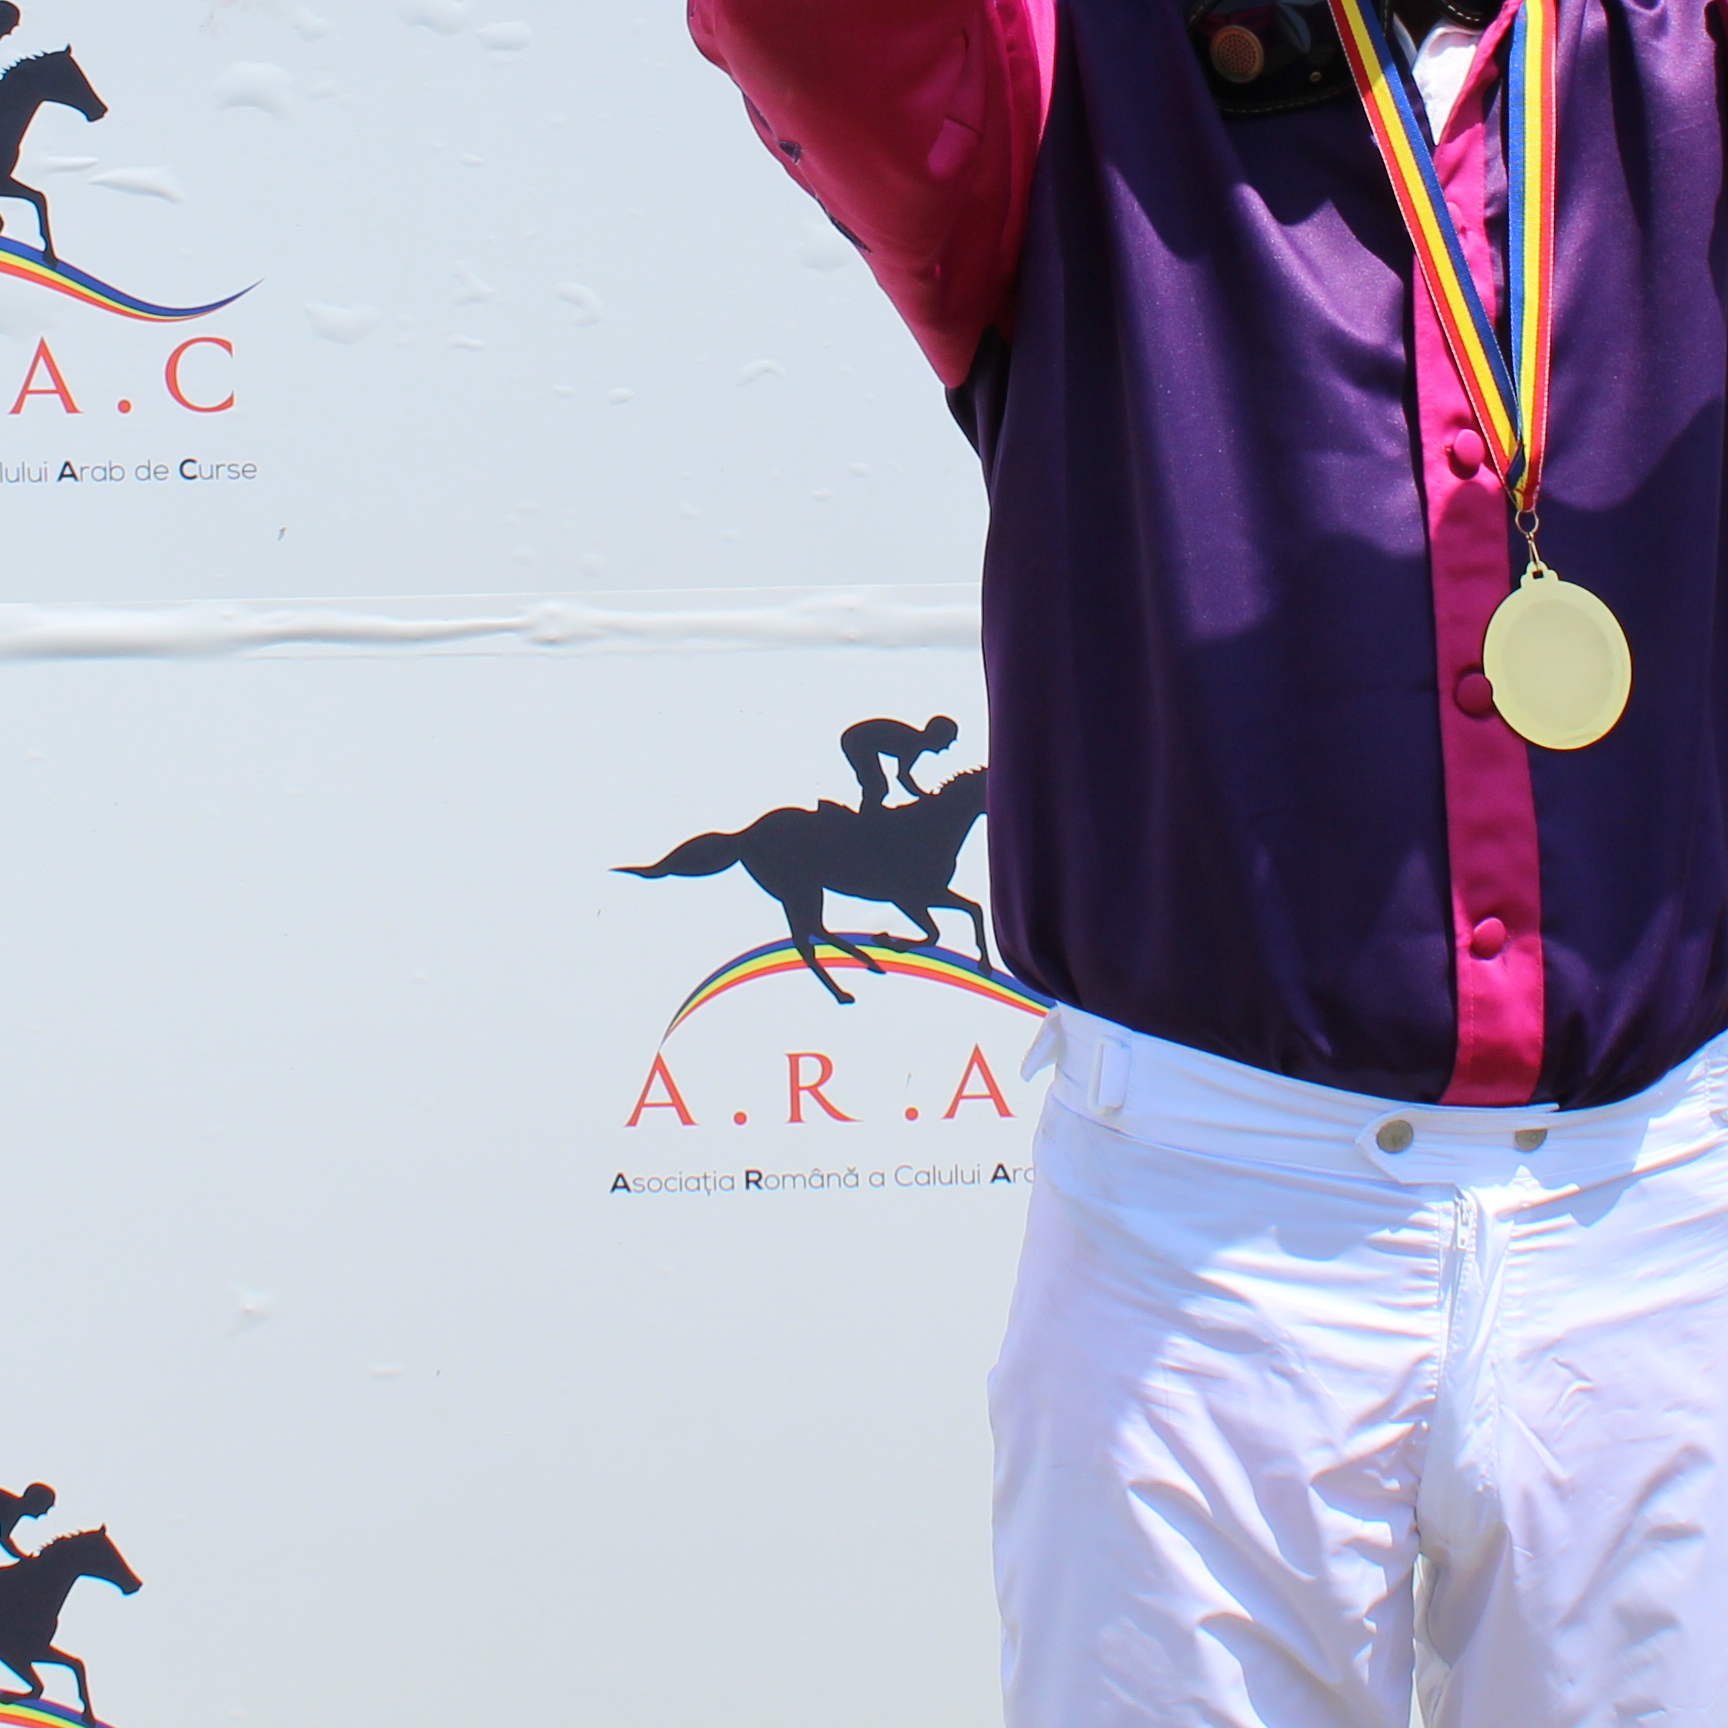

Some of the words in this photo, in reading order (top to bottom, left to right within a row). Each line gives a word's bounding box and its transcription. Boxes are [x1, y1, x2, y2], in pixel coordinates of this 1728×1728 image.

[56, 459, 126, 483] Arab
[135, 459, 169, 481] de
[178, 457, 258, 481] Curse
[609, 1171, 735, 1196] Asociația
[745, 1166, 859, 1191] Română
[869, 1170, 885, 1189] a
[895, 1163, 981, 1188] Calului
[990, 1162, 1037, 1185] Ara
